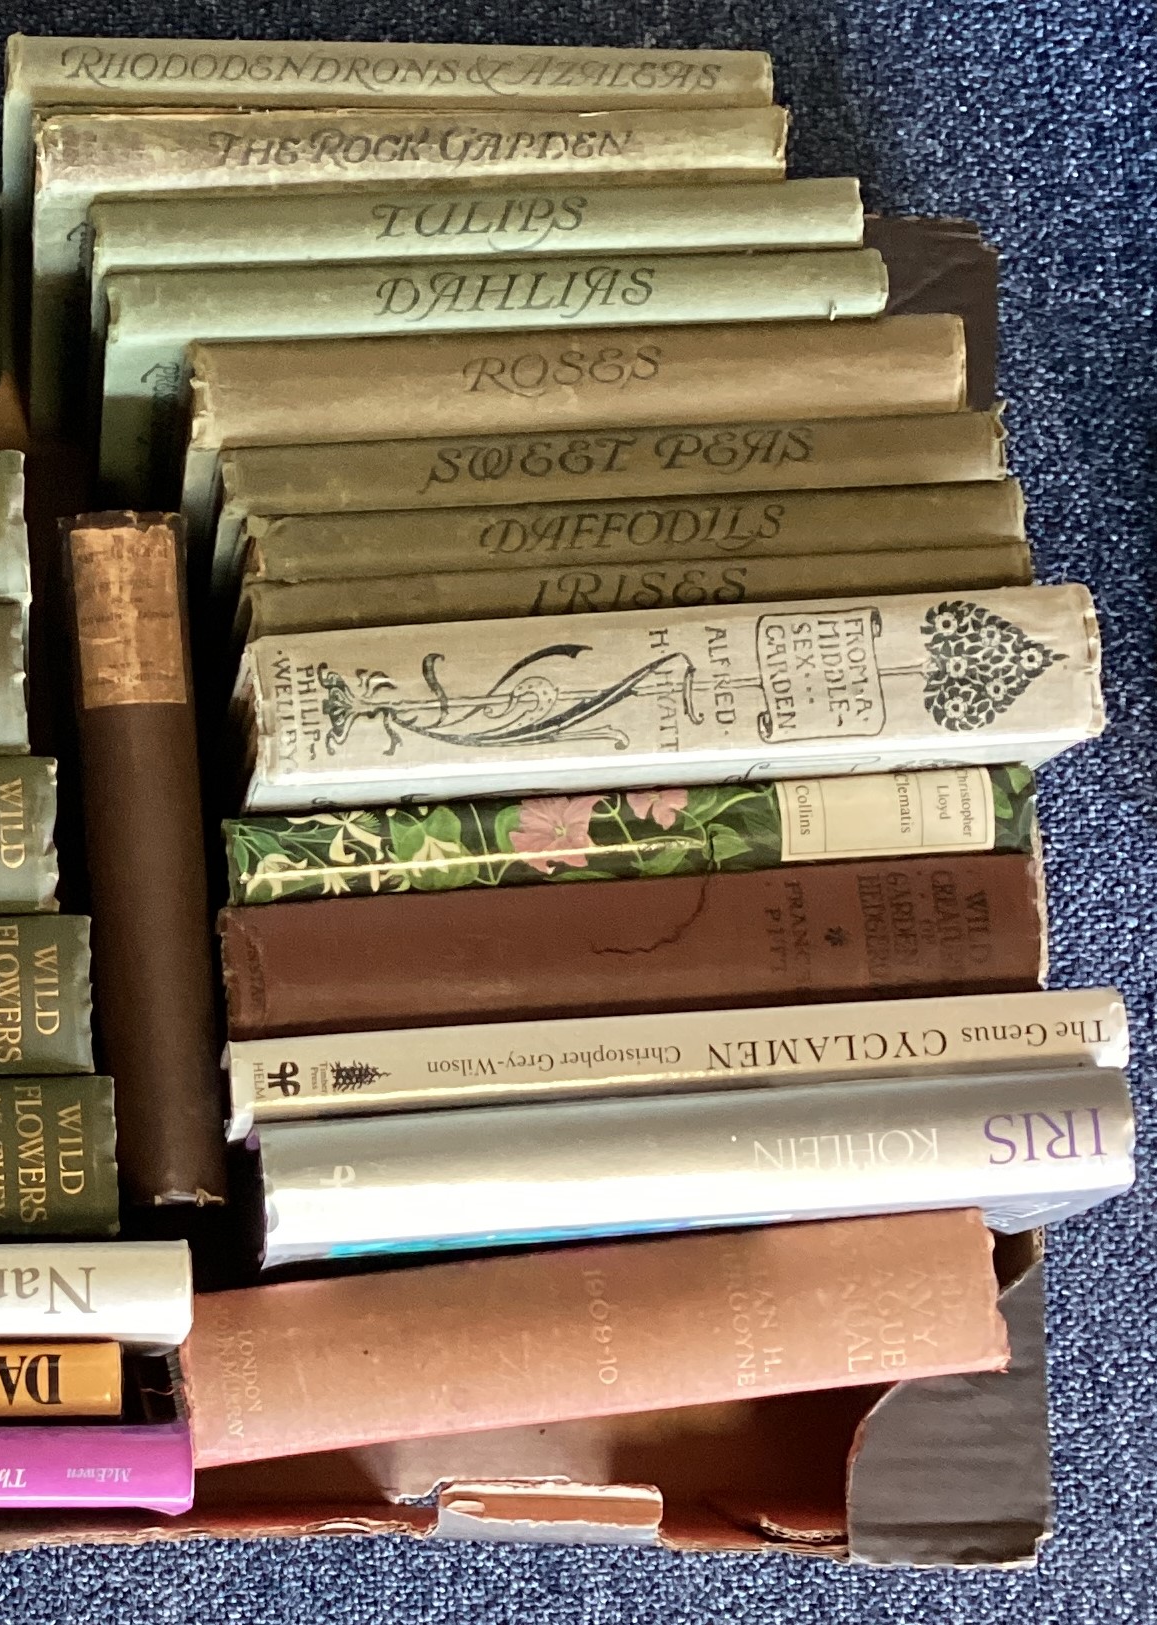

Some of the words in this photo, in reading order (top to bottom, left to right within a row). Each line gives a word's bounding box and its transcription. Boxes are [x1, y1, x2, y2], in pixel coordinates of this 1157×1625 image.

[62, 45, 460, 91] RHODODENDRONS
[467, 53, 513, 93] &
[519, 54, 723, 90] AZALEAS
[211, 128, 296, 166] THE
[309, 128, 424, 166] ROCK
[437, 128, 635, 170] GARDEN
[370, 196, 588, 251] TULIPS
[377, 268, 657, 322] DAHLIAS
[463, 346, 662, 397] ROSES
[417, 436, 638, 494] SWEET
[654, 428, 814, 472] PEAS
[480, 504, 786, 555] DAFFODILS
[528, 568, 748, 616] IRISES
[764, 624, 796, 729] GARDEN
[818, 620, 849, 727] MIDDLE-
[653, 670, 678, 752] HYATT
[796, 785, 812, 835] Collins
[894, 775, 914, 833] Clematis
[936, 785, 951, 820] Lloyd
[955, 769, 974, 837] Christopher
[965, 891, 990, 964] WILD
[33, 944, 60, 1035] WILD
[560, 1042, 682, 1068] Christopher
[702, 1028, 947, 1071] CYCLAMEN
[961, 1023, 1047, 1049] Genus
[1054, 1018, 1110, 1045] The
[253, 1063, 266, 1099] HELM
[319, 1062, 328, 1093] Timber
[426, 1051, 554, 1080] Grey-Wilson
[13, 1085, 47, 1223] FLOWERS
[56, 1103, 85, 1195] WILD
[982, 1106, 1108, 1164] IRIS
[582, 1270, 618, 1385] 1909-10
[906, 1268, 938, 1347] AVY
[237, 1330, 263, 1412] LONDON
[66, 1467, 132, 1483] McEwen
